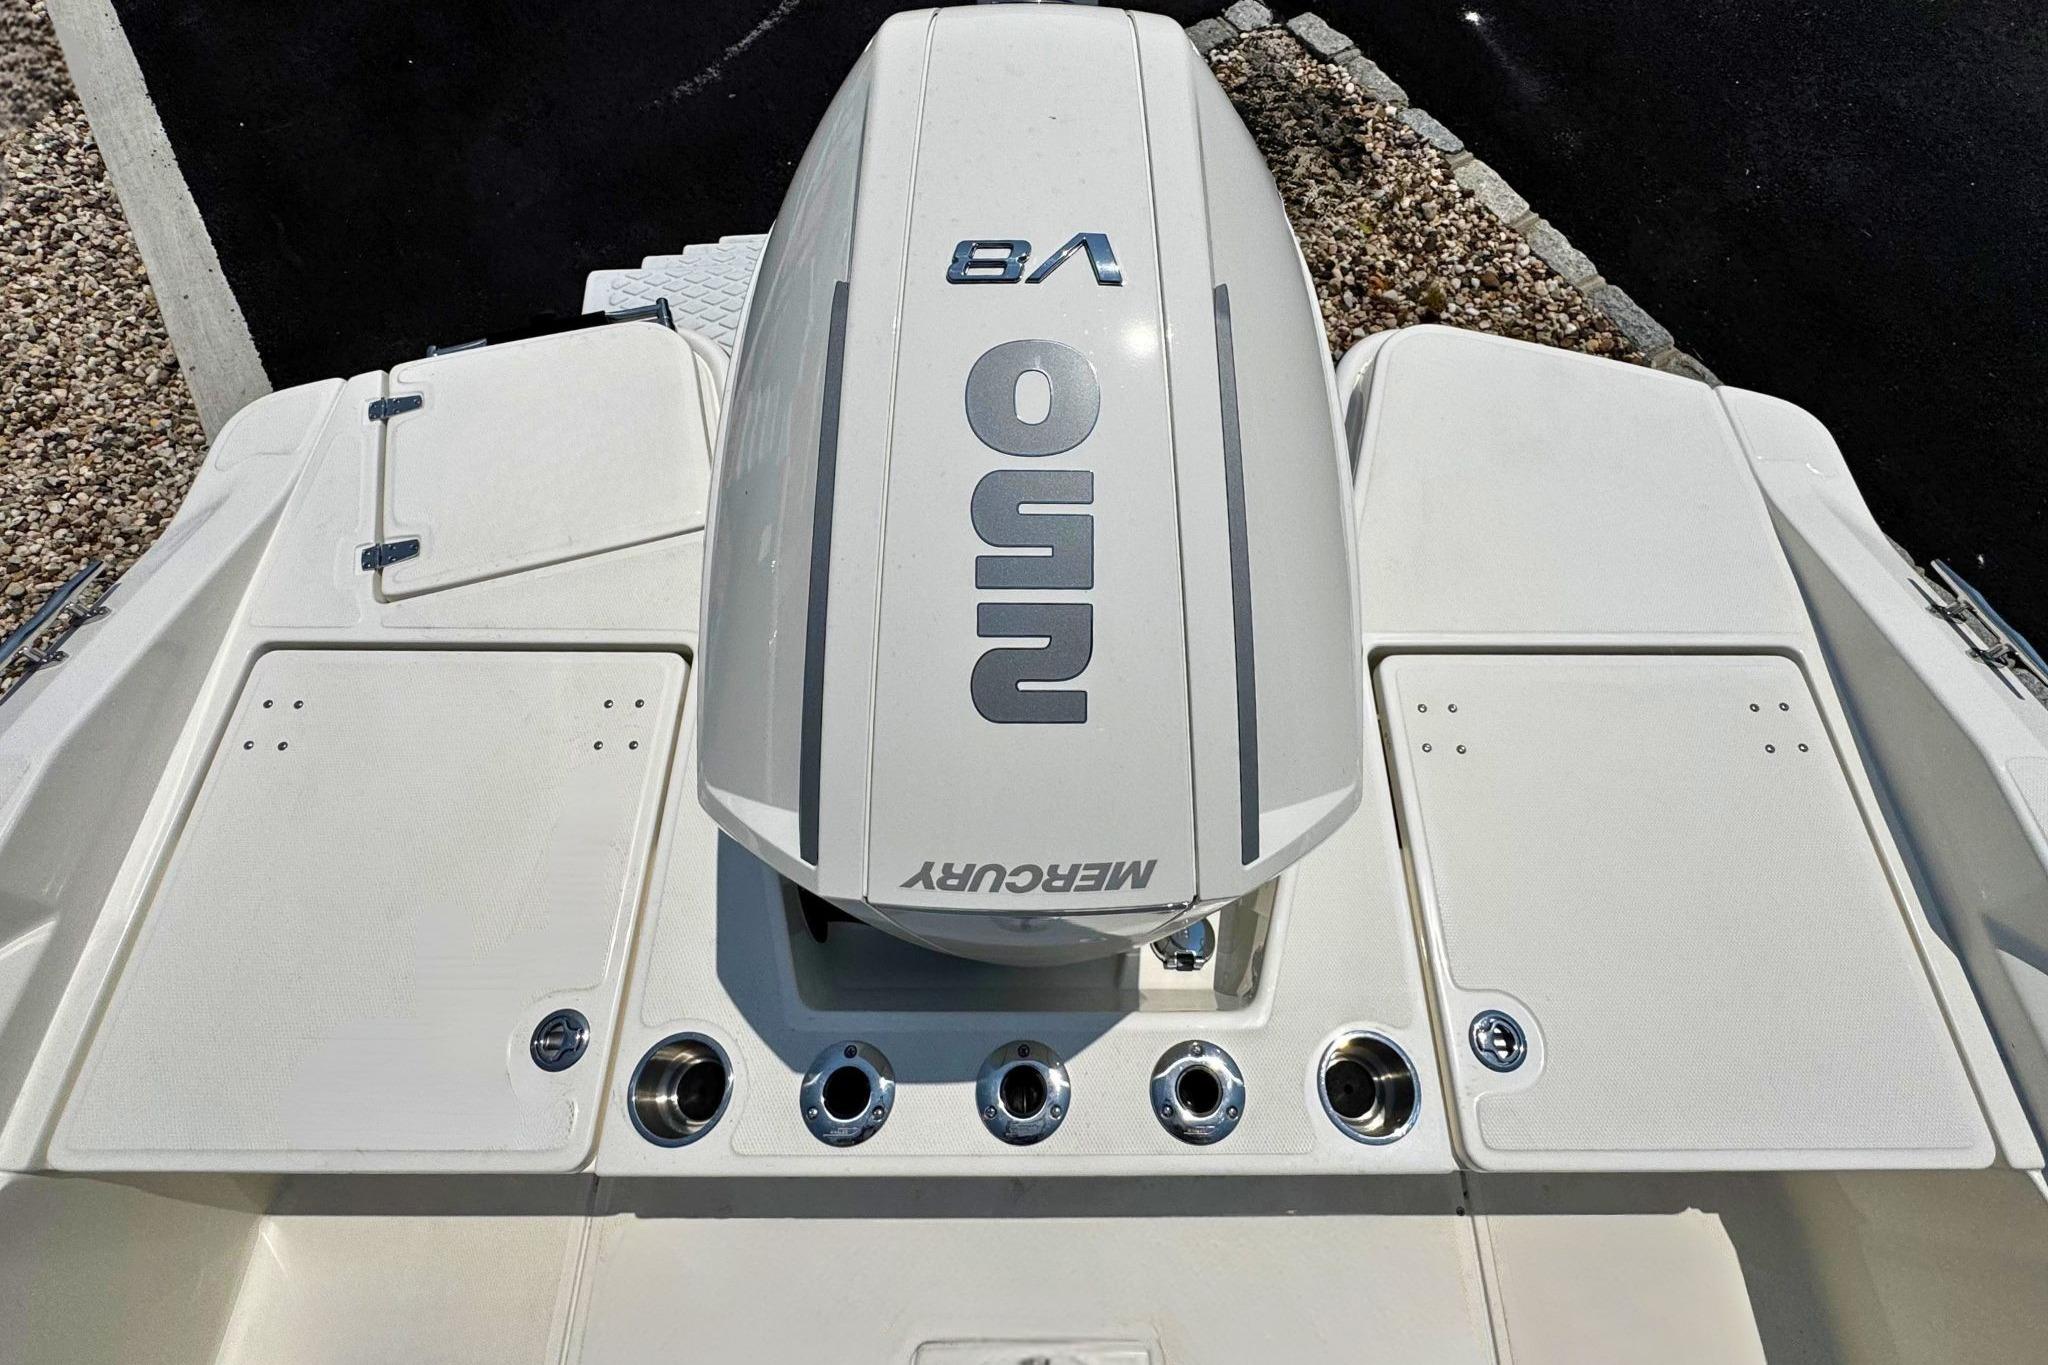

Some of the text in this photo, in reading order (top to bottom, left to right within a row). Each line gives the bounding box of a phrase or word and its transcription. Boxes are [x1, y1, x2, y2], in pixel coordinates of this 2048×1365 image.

[946, 232, 1124, 287] V8
[964, 339, 1100, 724] 250
[899, 859, 1158, 893] MERCURY
